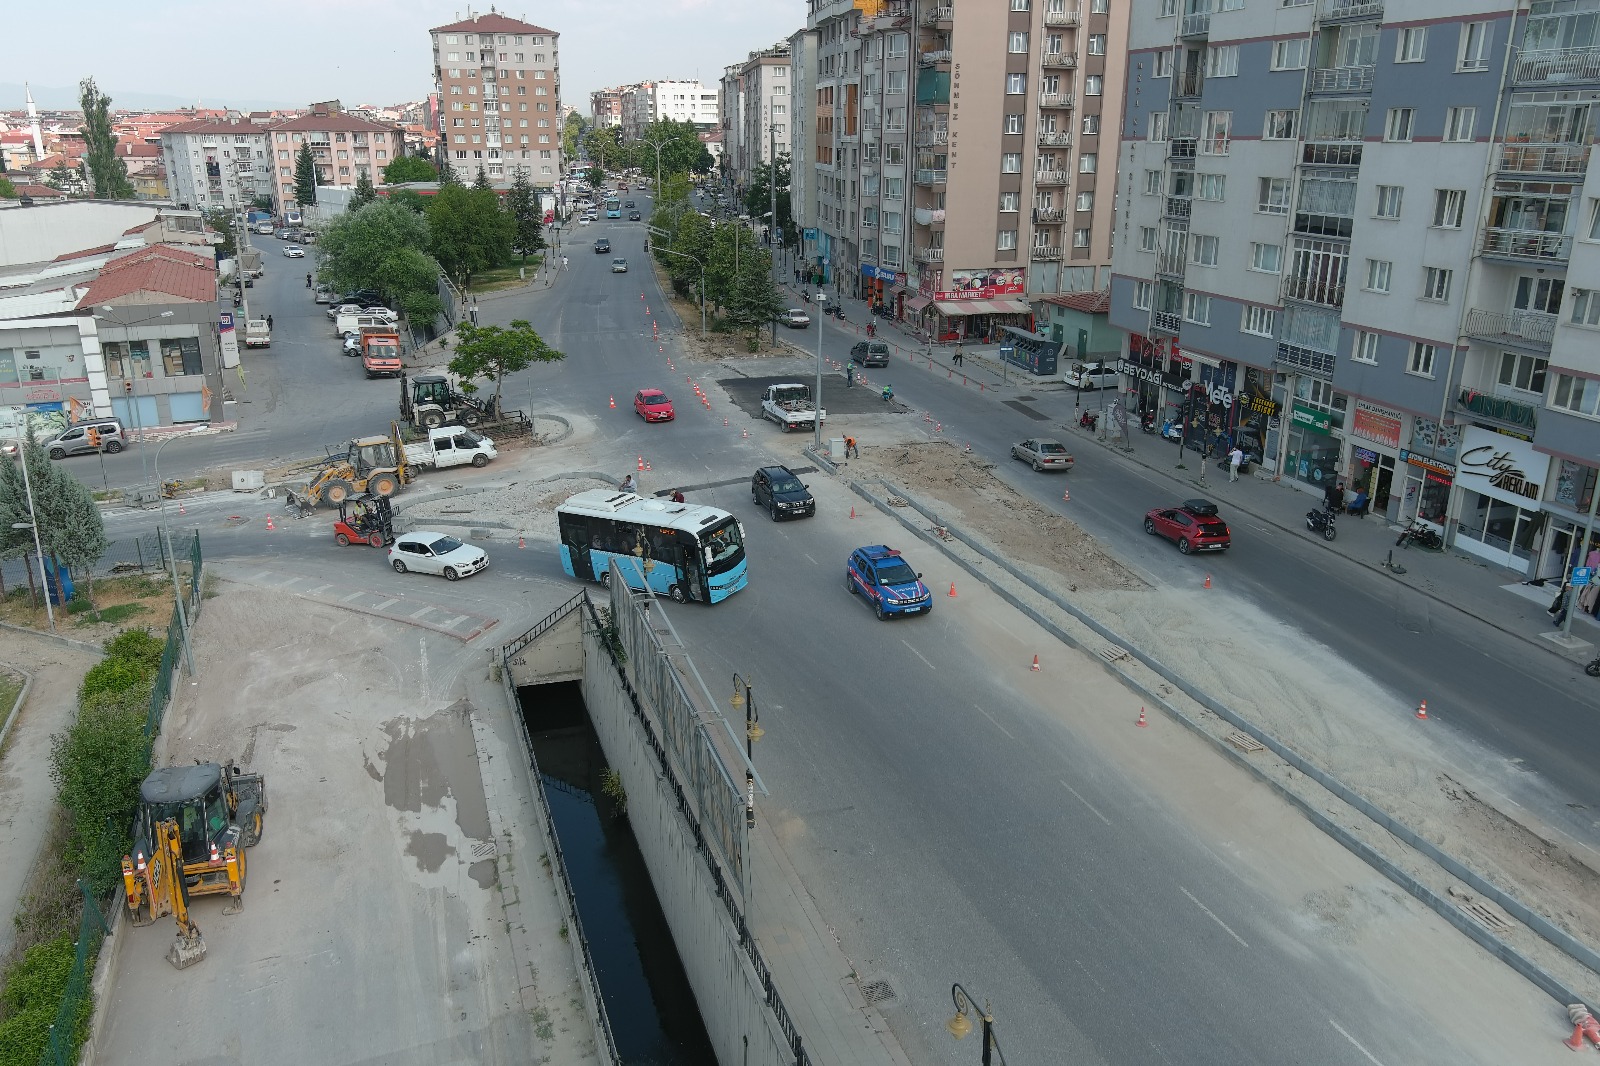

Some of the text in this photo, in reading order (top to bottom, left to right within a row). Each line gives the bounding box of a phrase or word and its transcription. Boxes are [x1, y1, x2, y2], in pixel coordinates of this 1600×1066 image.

[1124, 362, 1163, 385] BEYDAĞI
[1461, 445, 1517, 482] City
[1503, 475, 1538, 500] REKLAM
